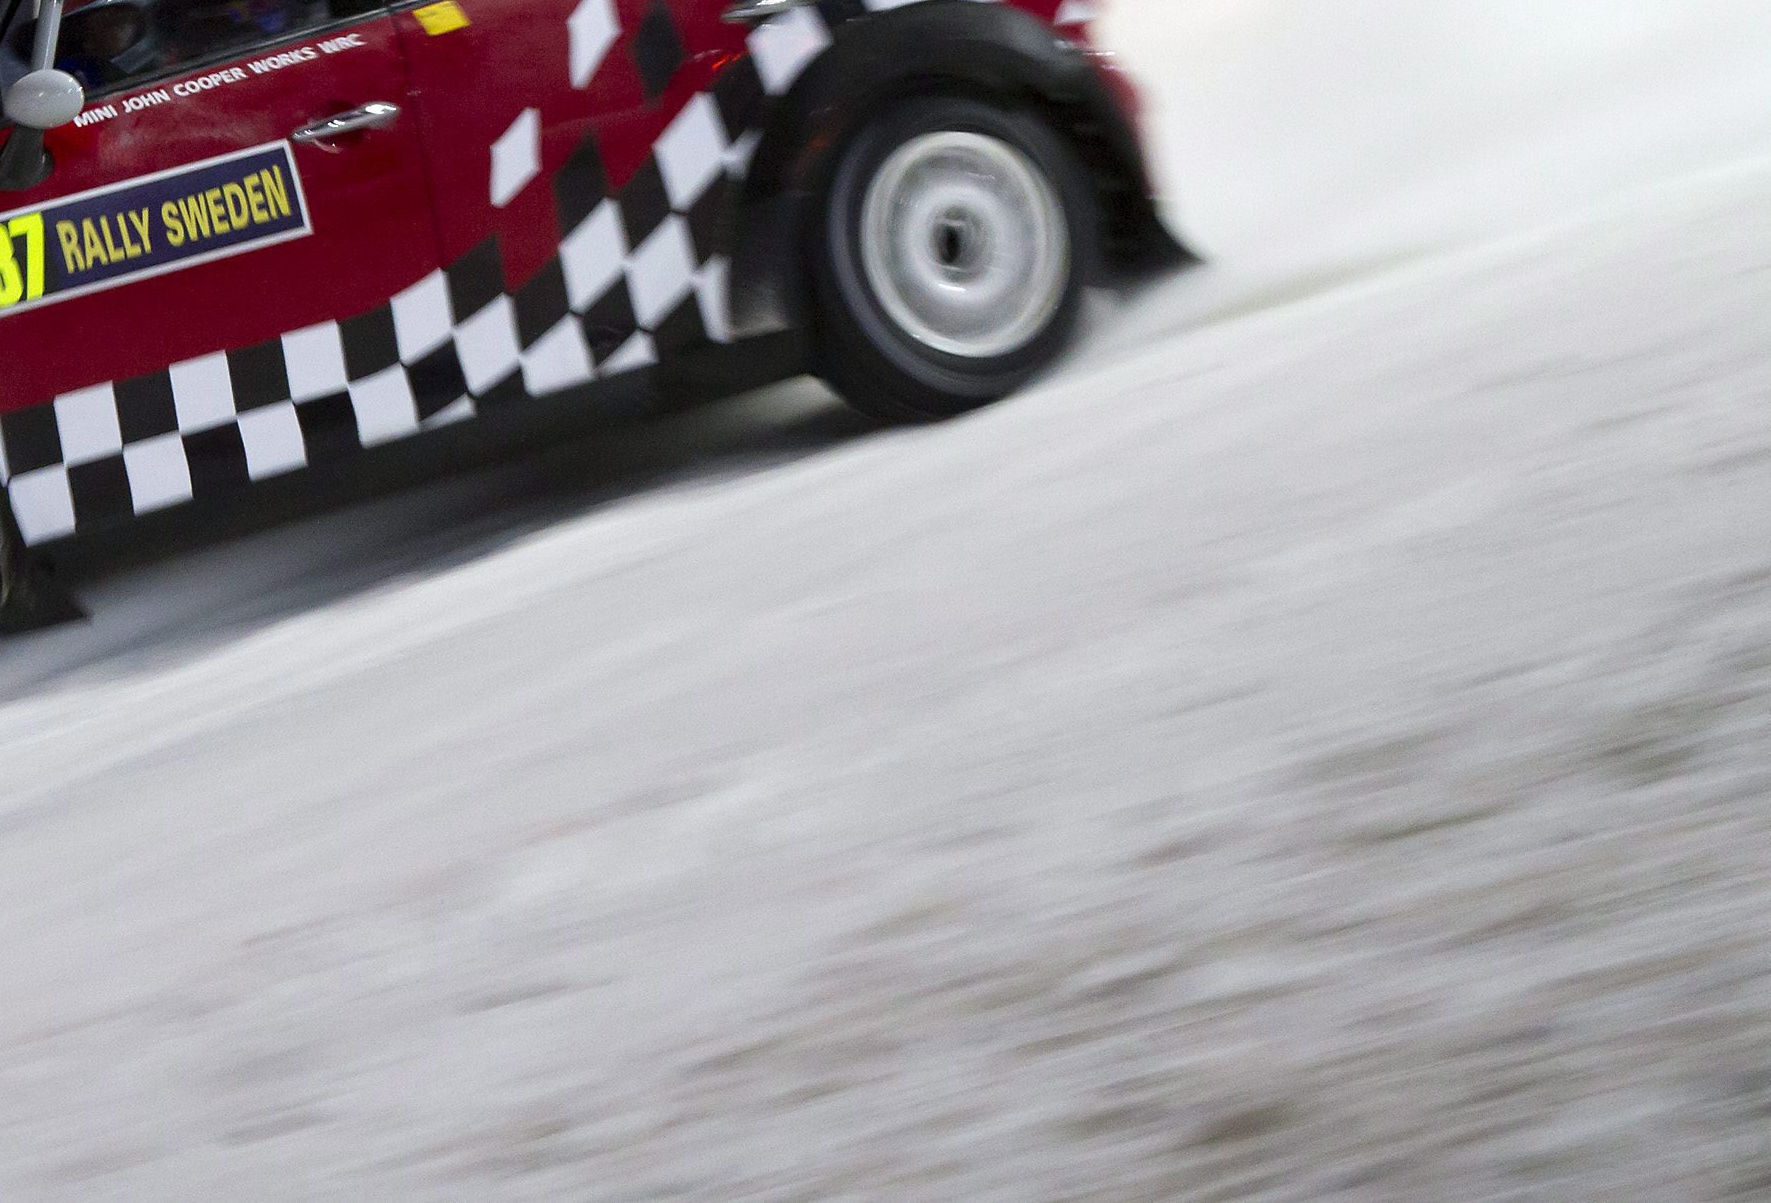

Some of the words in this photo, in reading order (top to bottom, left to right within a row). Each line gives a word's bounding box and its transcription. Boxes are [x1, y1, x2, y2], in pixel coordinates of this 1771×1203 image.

[73, 104, 118, 128] MINI
[121, 88, 171, 114] JOHN
[172, 66, 248, 97] COOPER
[247, 46, 319, 75] WORKS
[316, 32, 367, 55] WRC
[56, 207, 152, 274] RALLY
[160, 164, 291, 247] SWEDEN
